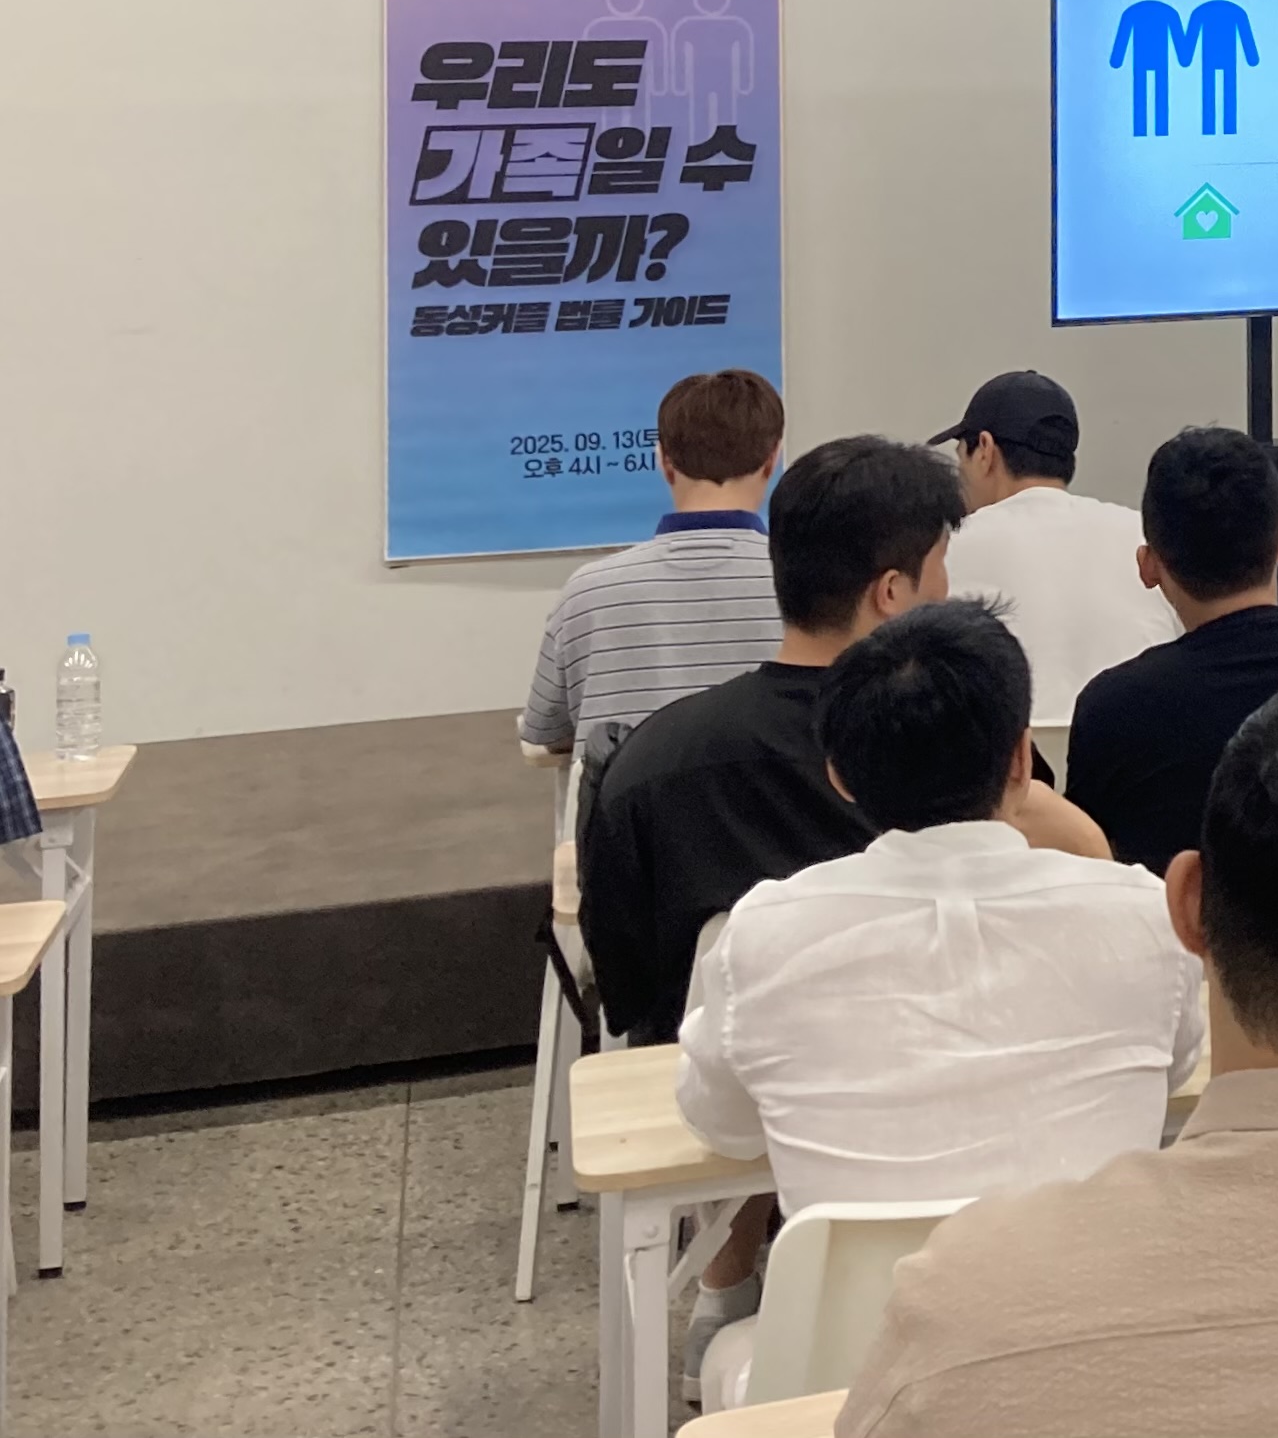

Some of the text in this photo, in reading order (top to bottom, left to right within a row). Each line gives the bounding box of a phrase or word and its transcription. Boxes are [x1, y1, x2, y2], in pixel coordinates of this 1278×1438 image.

[411, 40, 648, 109] 우리도
[409, 123, 757, 205] 가족일 수
[411, 213, 690, 290] 있을까?
[410, 294, 731, 337] 동성커플 법률 가이드
[510, 428, 659, 455] 2025. 09. 13(토
[523, 457, 563, 478] 오후
[568, 455, 600, 476] 4시
[624, 452, 656, 472] 6시
